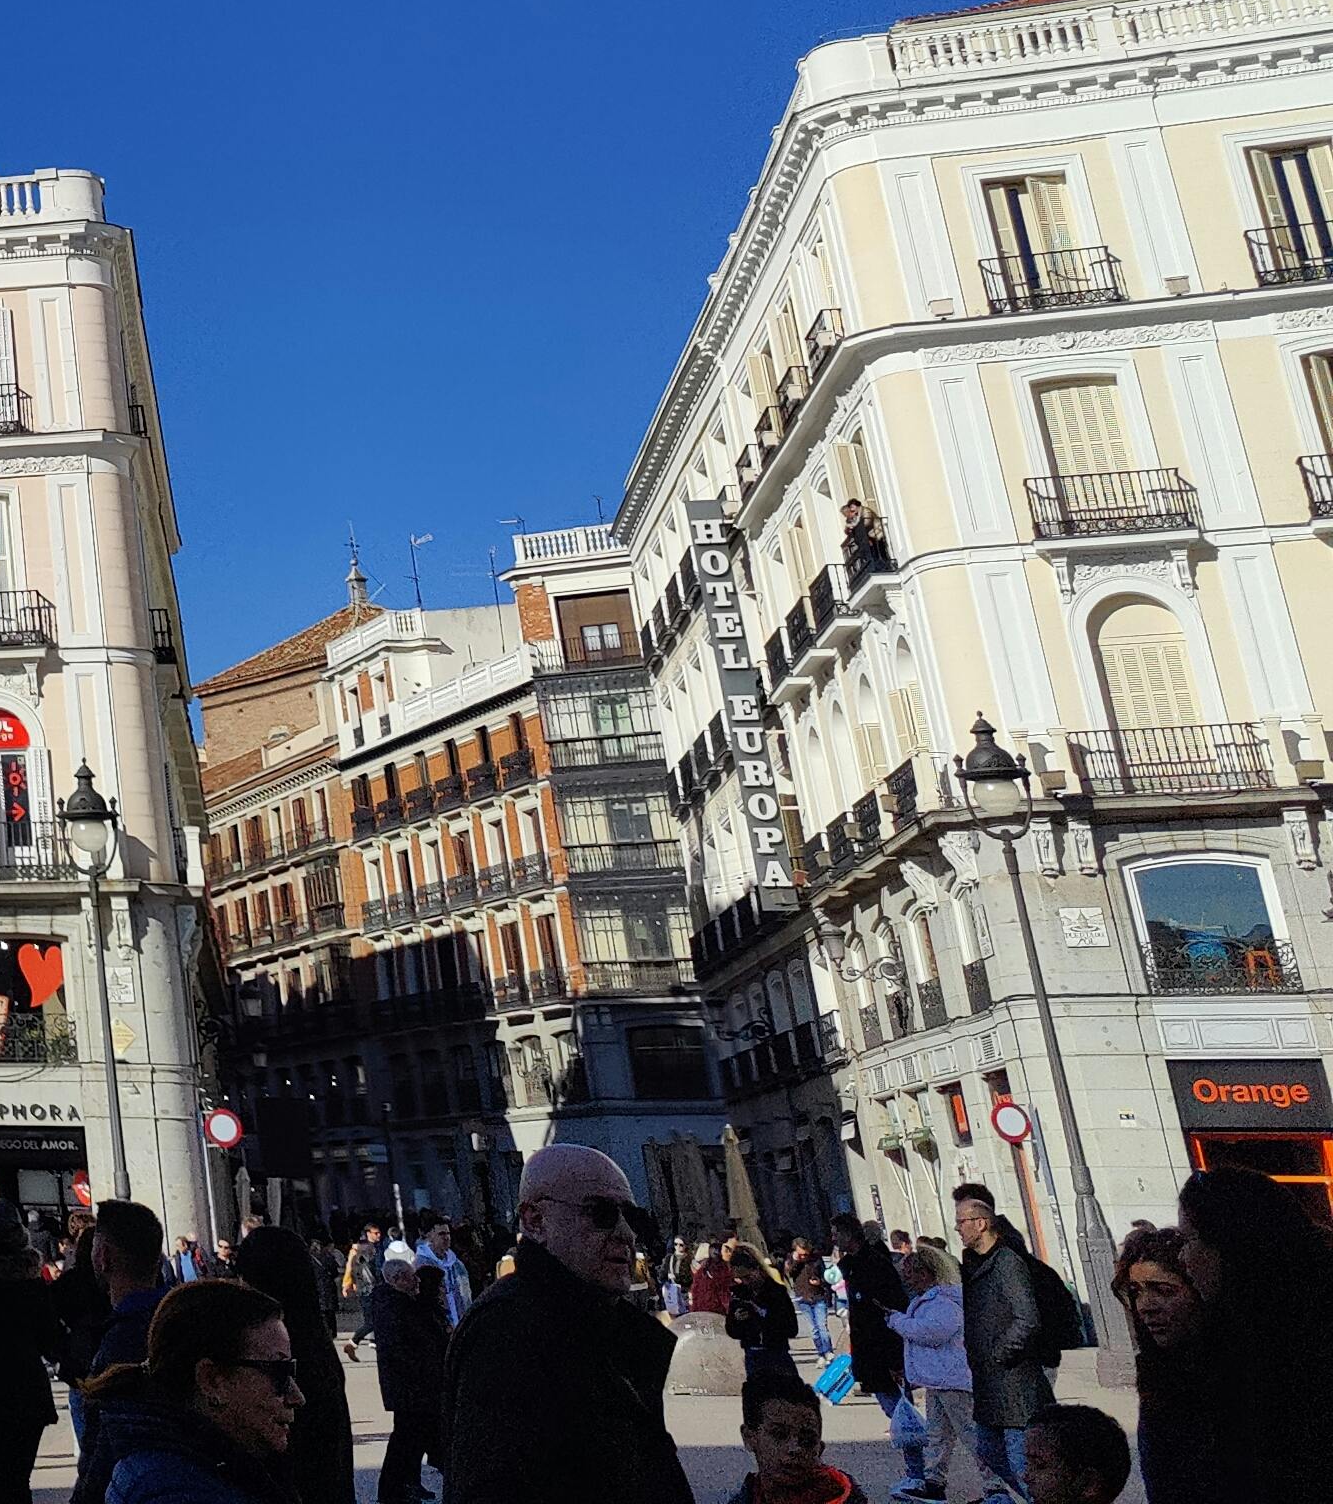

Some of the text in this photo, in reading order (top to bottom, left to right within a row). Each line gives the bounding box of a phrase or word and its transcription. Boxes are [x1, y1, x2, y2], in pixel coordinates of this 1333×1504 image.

[690, 518, 793, 888] HOTEL EUROPA
[1192, 1078, 1311, 1109] Orange
[23, 1139, 40, 1150] DEL
[41, 1139, 79, 1151] AMOR.
